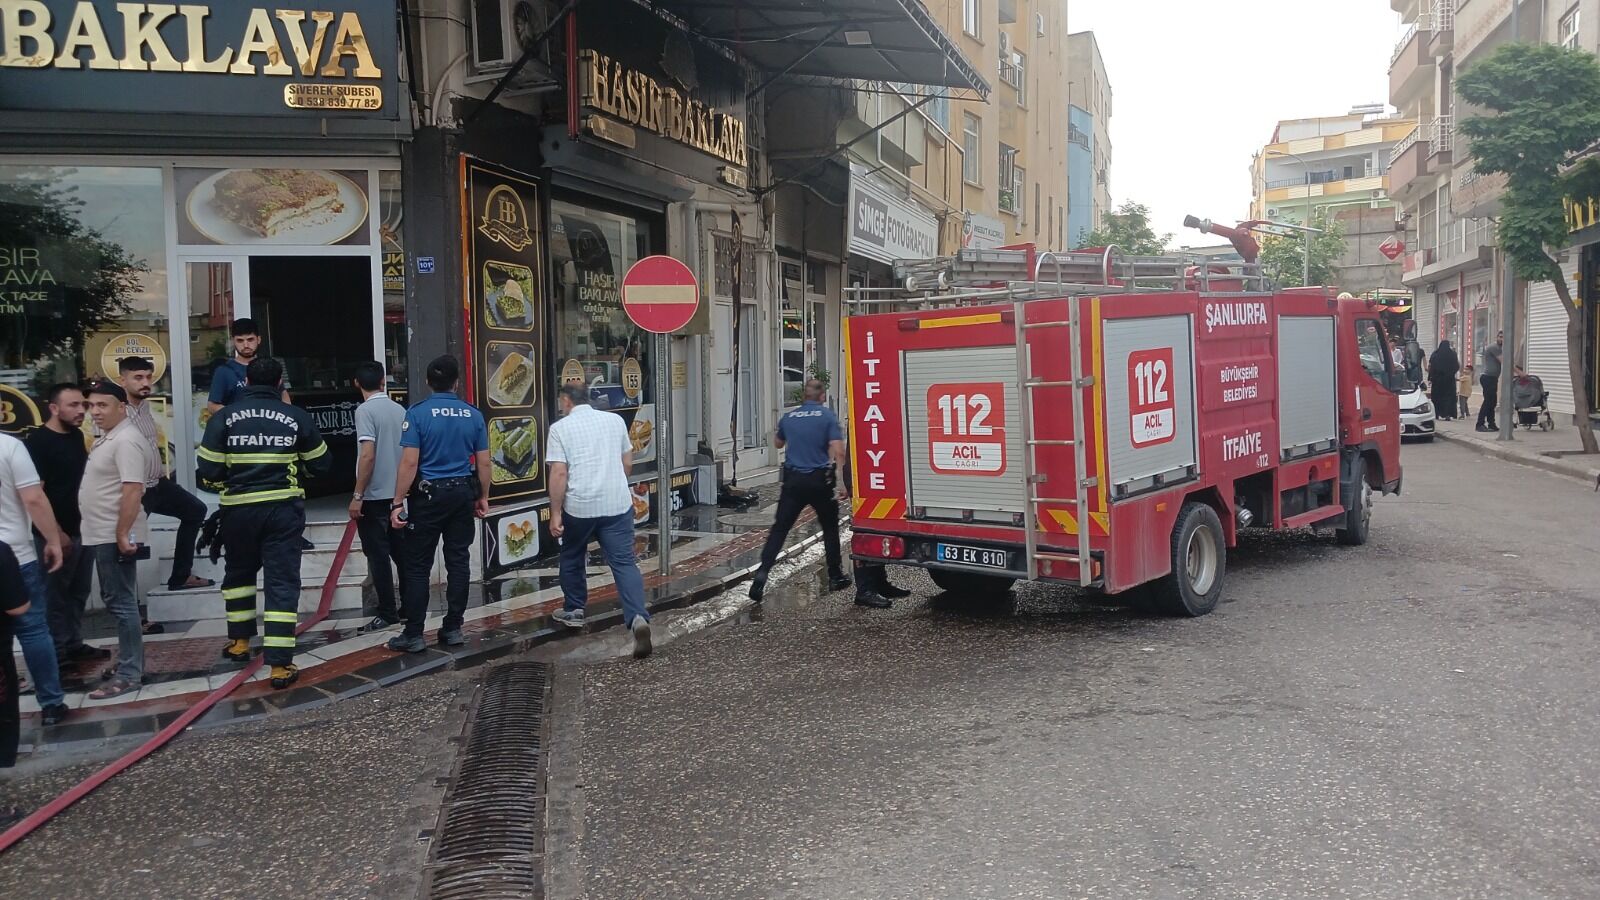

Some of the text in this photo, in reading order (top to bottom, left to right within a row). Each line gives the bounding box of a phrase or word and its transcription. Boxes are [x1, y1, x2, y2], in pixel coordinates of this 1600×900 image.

[0, 0, 382, 78] BAKLAVA
[591, 49, 748, 167] HASIR BAKLAVA
[858, 197, 885, 239] SİMGE
[0, 269, 57, 285] AVA
[584, 270, 617, 288] HASIR
[10, 291, 49, 301] TAZE
[579, 286, 621, 303] BAKLAVA
[1205, 303, 1268, 332] ŞANLIURFA
[1134, 359, 1168, 406] 112
[1220, 363, 1259, 384] BÜYÜKŞEHİR
[1223, 382, 1258, 403] BELEDİYESİ
[225, 408, 299, 432] ŞANLIURFA
[311, 411, 340, 429] ASIR
[938, 393, 993, 436] 112
[1223, 429, 1262, 462] İTFAİYE
[1259, 453, 1269, 468] 112
[945, 546, 1004, 566] 63 EK 810
